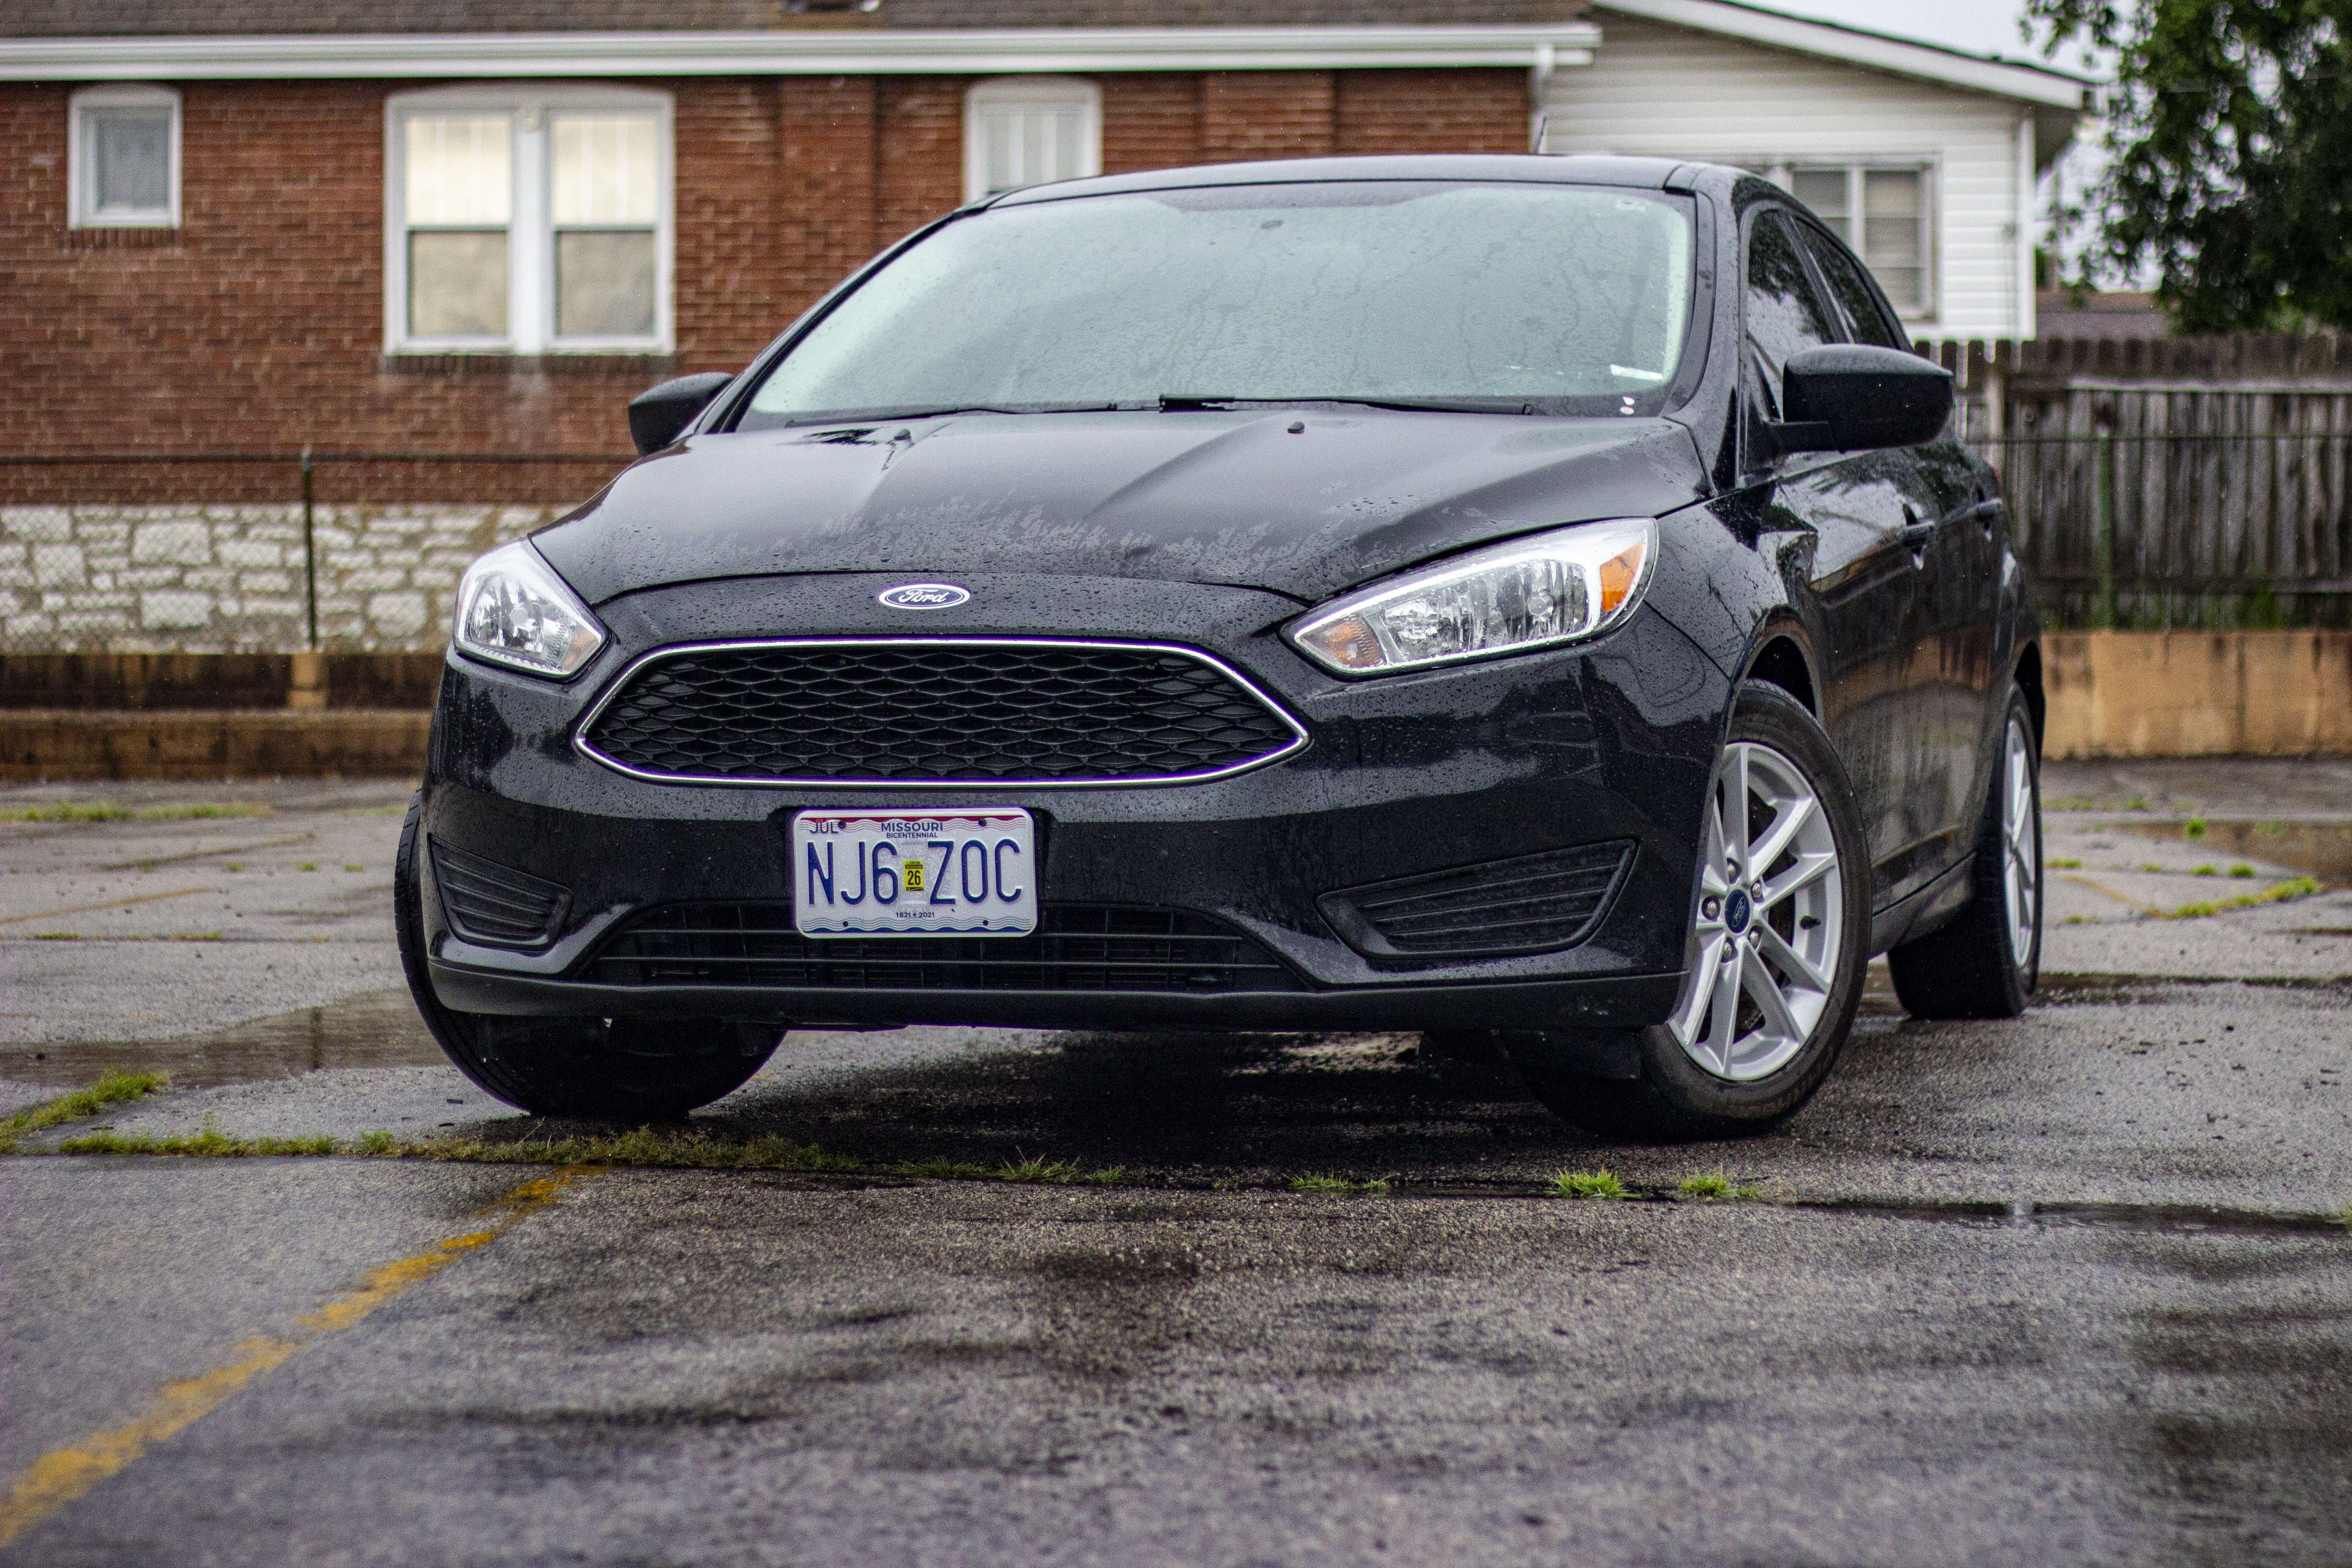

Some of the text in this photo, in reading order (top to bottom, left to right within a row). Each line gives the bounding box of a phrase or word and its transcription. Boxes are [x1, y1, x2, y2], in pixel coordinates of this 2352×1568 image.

[898, 589, 950, 603] Ford
[810, 822, 838, 834] JUL
[881, 822, 943, 832] MISSOURI
[808, 841, 898, 905] NJ6
[908, 870, 921, 885] 26
